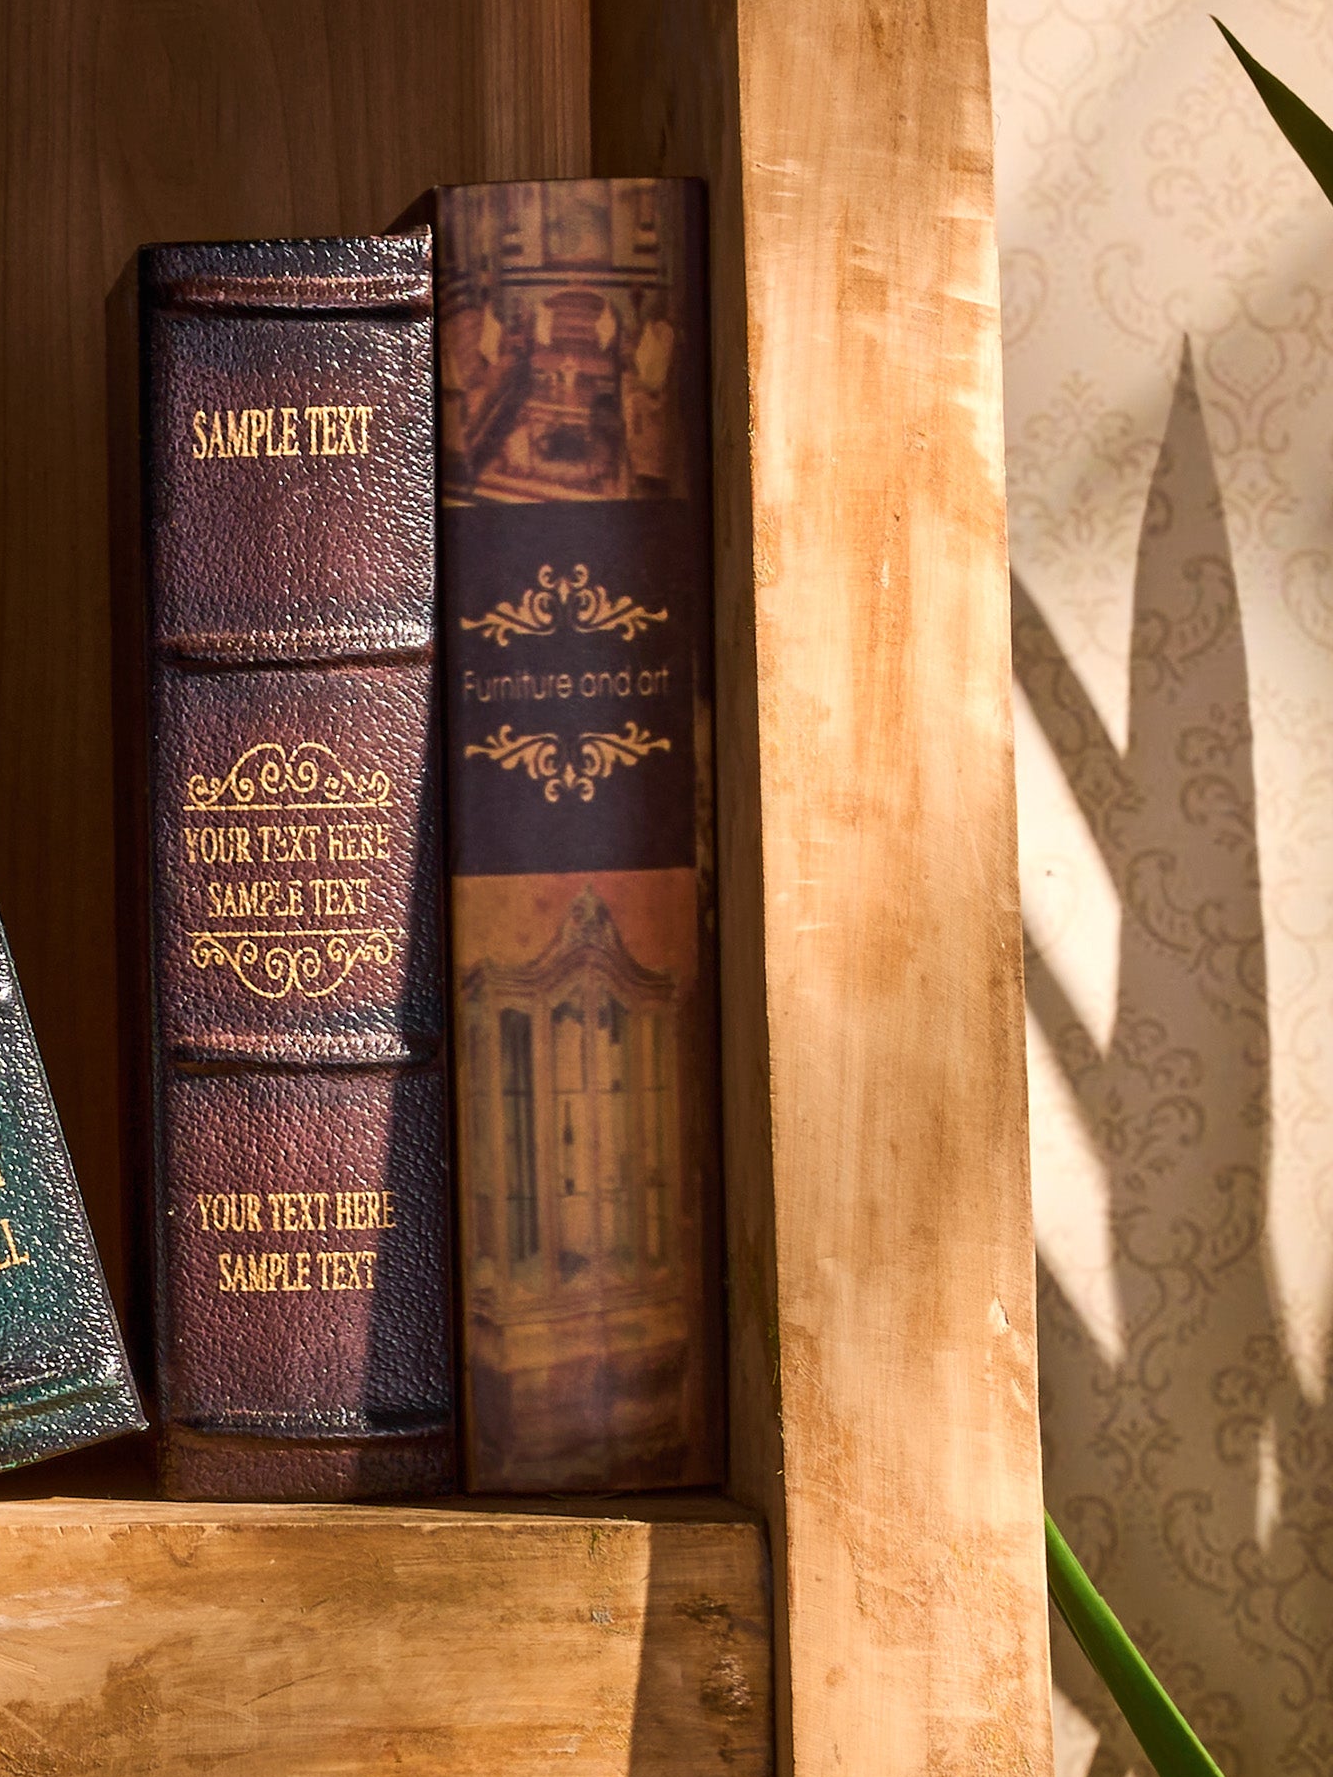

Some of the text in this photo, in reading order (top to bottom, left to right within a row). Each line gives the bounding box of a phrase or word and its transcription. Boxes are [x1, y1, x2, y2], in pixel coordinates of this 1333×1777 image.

[191, 405, 374, 460] SAMPLE TEXT
[581, 669, 632, 699] and
[637, 668, 670, 698] art
[183, 820, 393, 865] YOUR TEXT HERE
[207, 877, 373, 920] SAMPLE TEXT
[196, 1189, 398, 1234] YOUR TEXT HERE
[217, 1250, 379, 1294] SAMPLE TEXT
